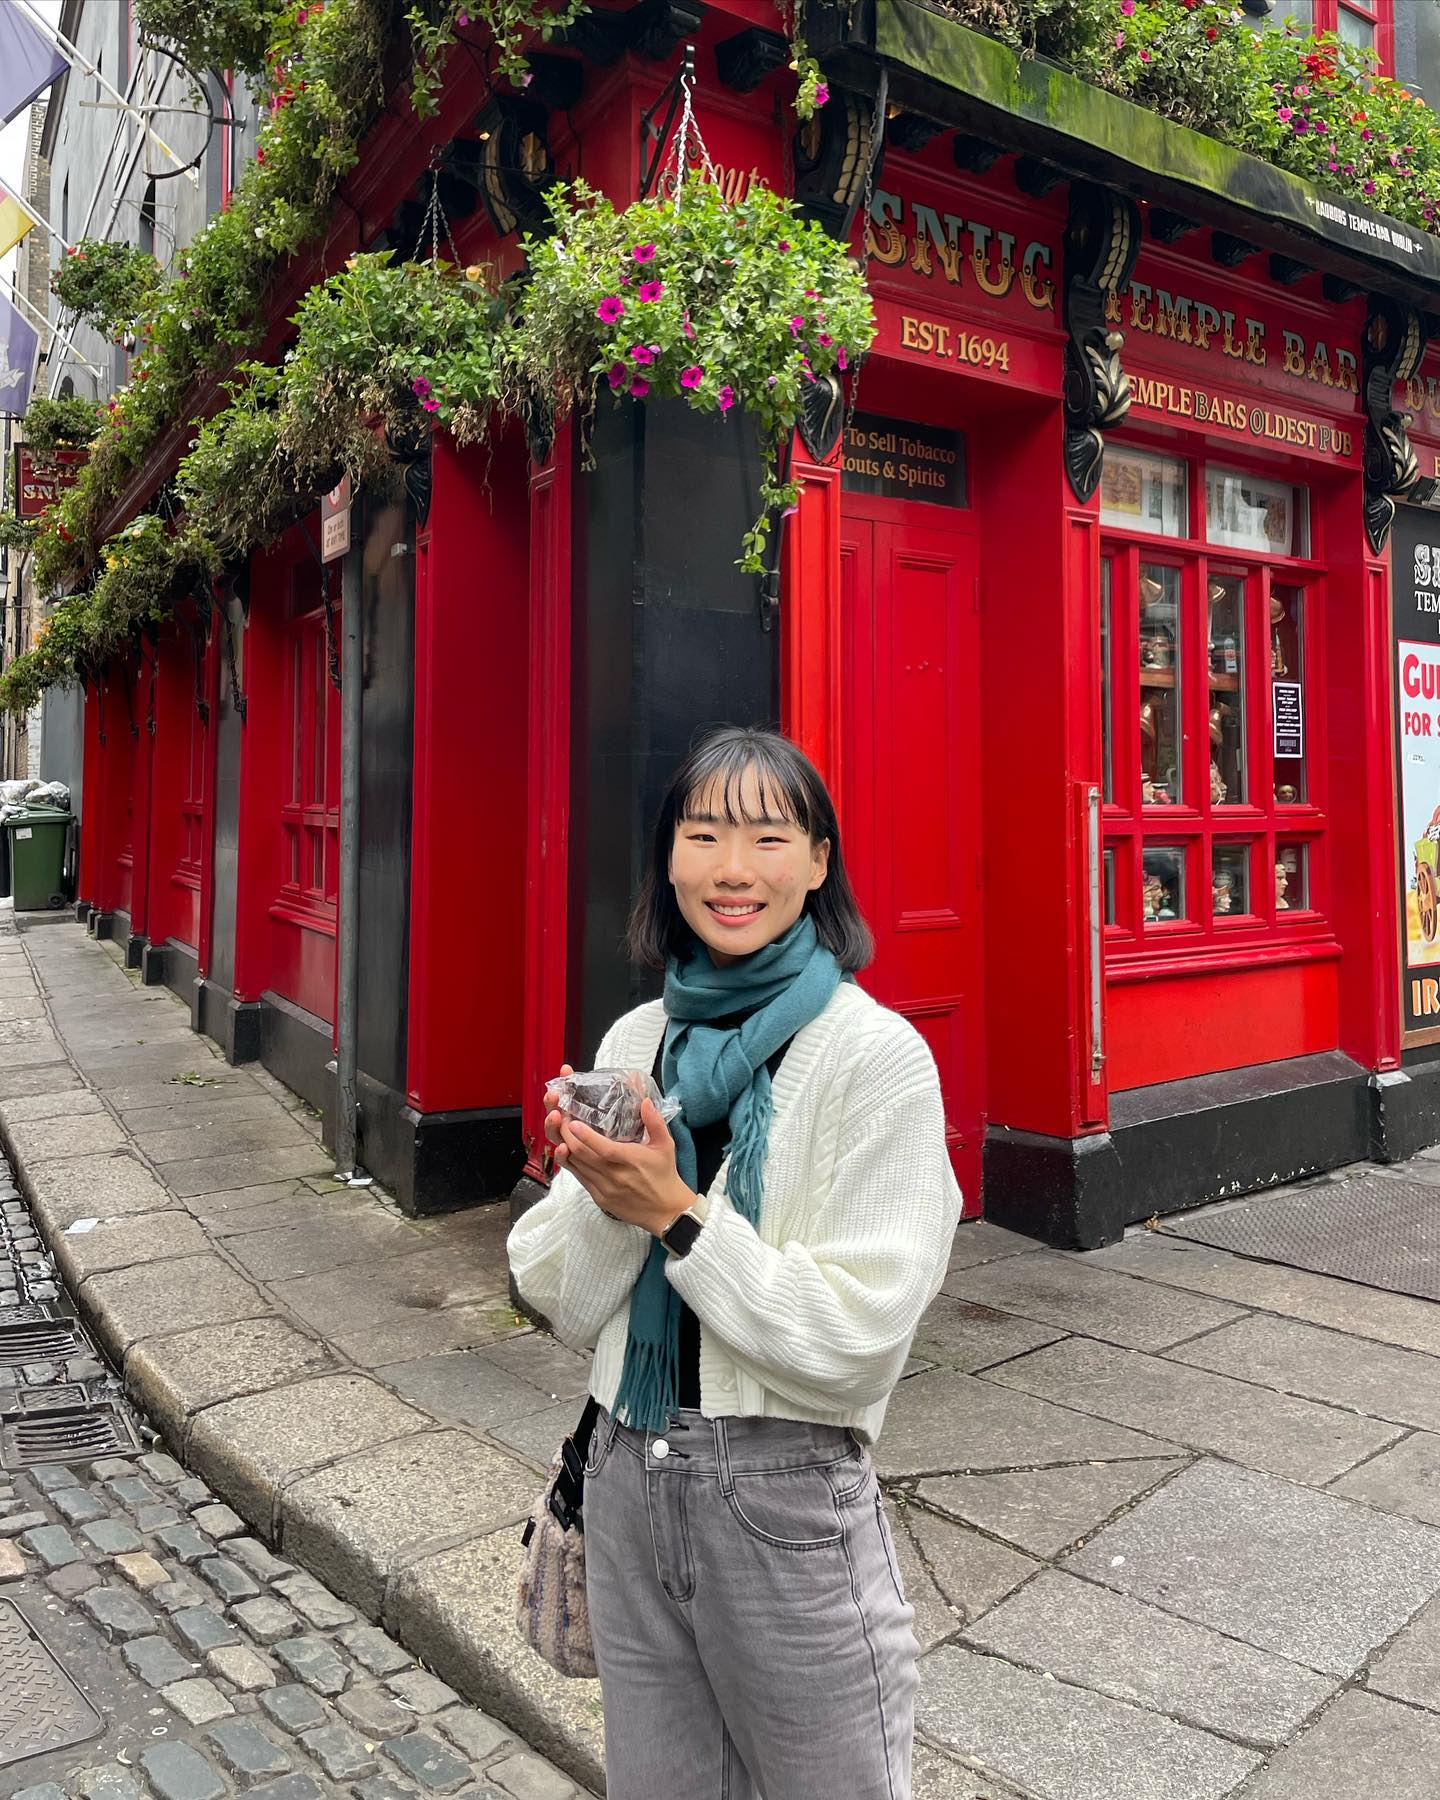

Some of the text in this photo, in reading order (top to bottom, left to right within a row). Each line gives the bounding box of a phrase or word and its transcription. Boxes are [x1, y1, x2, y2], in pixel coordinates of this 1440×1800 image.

[866, 189, 1055, 311] SNUG
[902, 316, 1010, 372] EST. 1694
[1283, 330, 1360, 395] BAR
[1129, 374, 1352, 456] EMPLE BARS OLDEST PUB
[846, 427, 956, 464] To Sell Tobacco
[841, 454, 945, 488] touts & Spirits
[24, 485, 58, 500] SN
[1405, 712, 1432, 737] FOR
[1412, 978, 1440, 1016] IR
